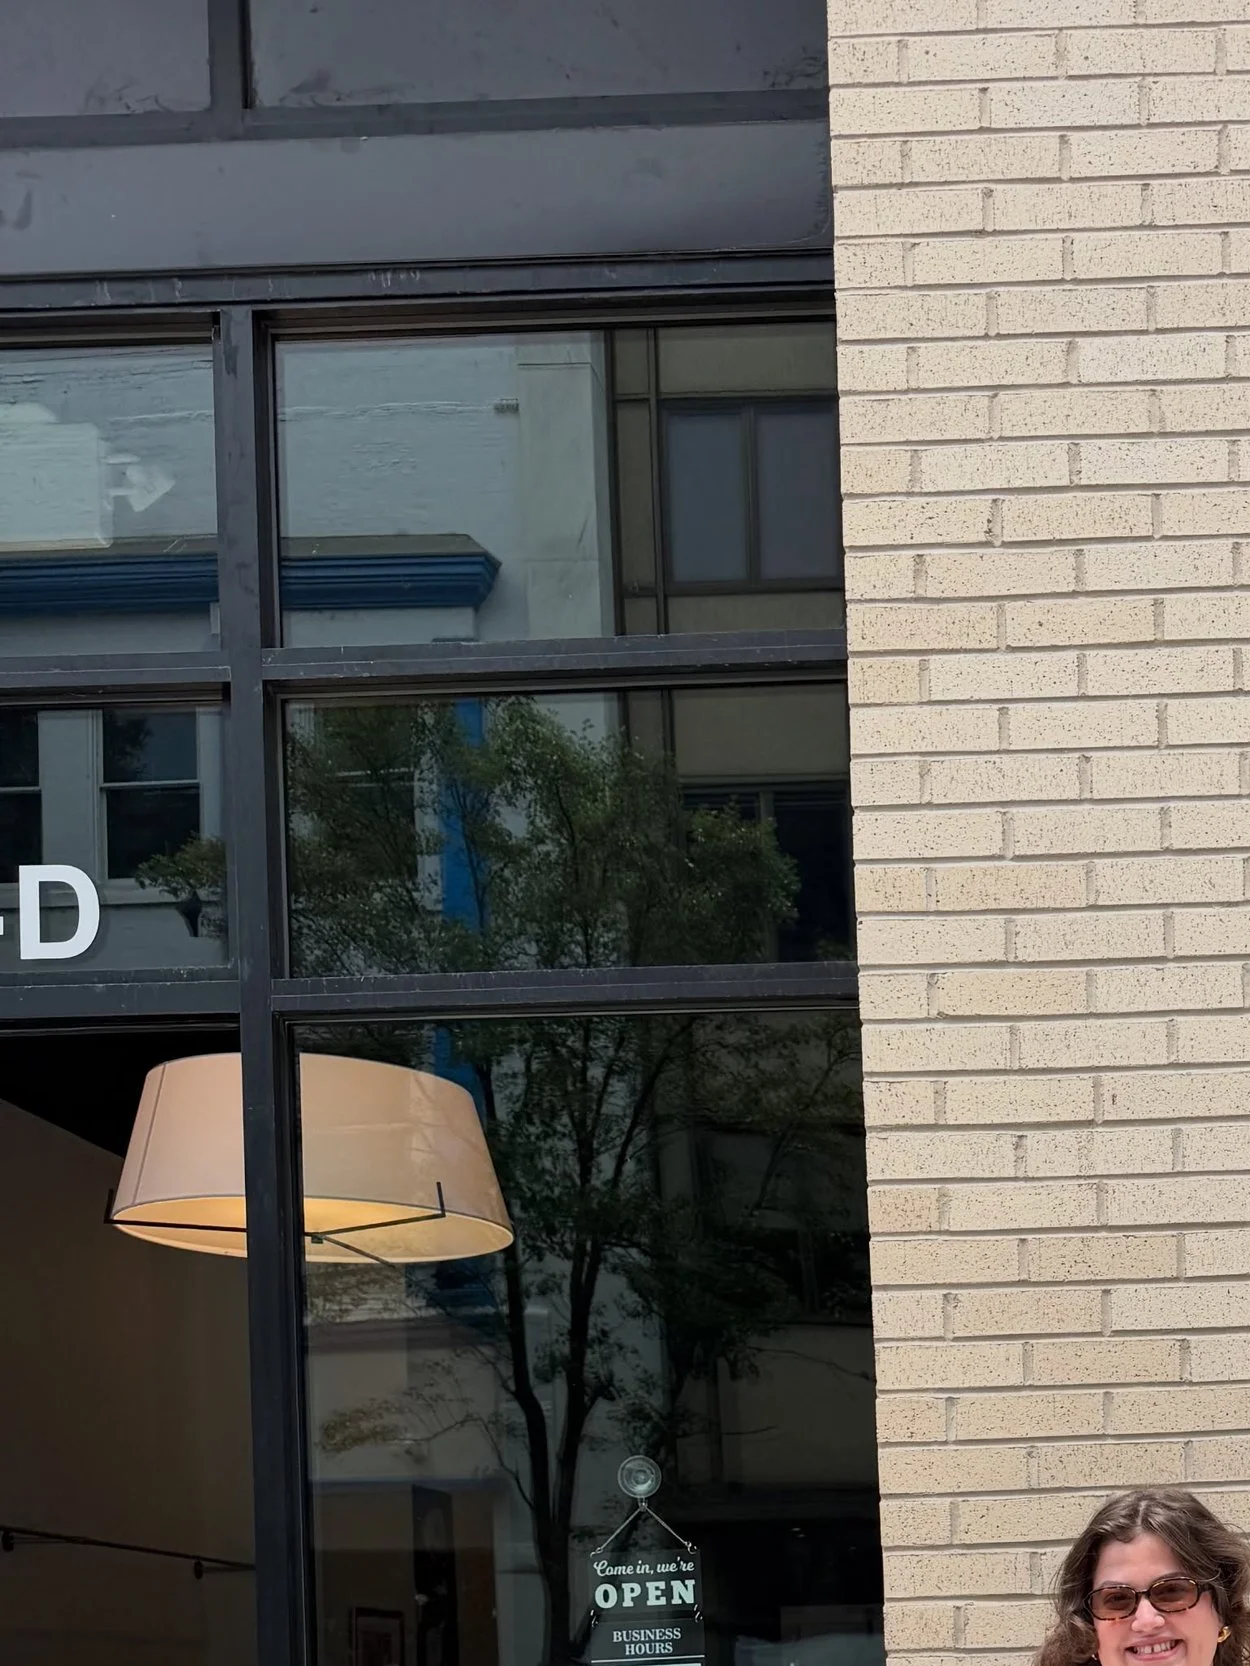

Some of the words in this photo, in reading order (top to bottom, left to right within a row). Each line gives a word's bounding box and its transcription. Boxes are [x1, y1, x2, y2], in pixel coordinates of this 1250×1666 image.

[593, 1560, 634, 1577] Come
[636, 1560, 654, 1575] in,
[656, 1556, 695, 1573] we're
[595, 1579, 696, 1609] OPEN
[612, 1628, 681, 1643] BUSINESS
[625, 1642, 673, 1656] HOURS
